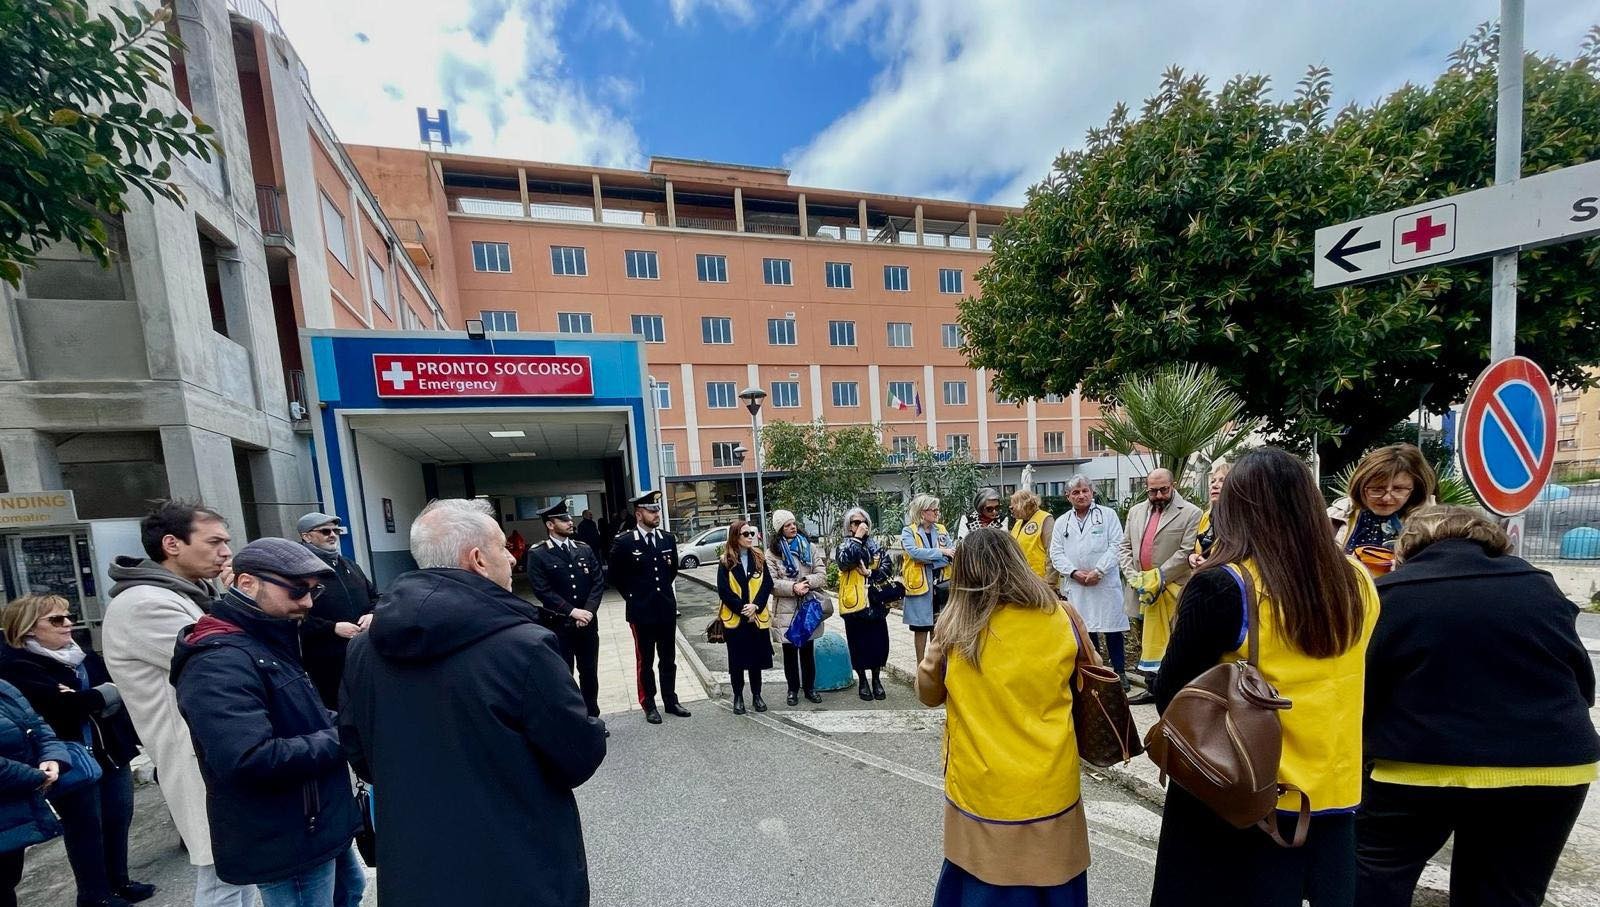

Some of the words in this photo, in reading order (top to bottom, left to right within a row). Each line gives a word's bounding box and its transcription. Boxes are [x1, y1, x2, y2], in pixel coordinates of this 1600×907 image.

[416, 107, 452, 147] H
[1569, 196, 1599, 222] S
[416, 362, 489, 375] PRONTO
[494, 362, 584, 376] SOCCORSO
[418, 378, 497, 392] Emergency
[0, 494, 66, 509] NDING
[0, 513, 48, 523] omatic
